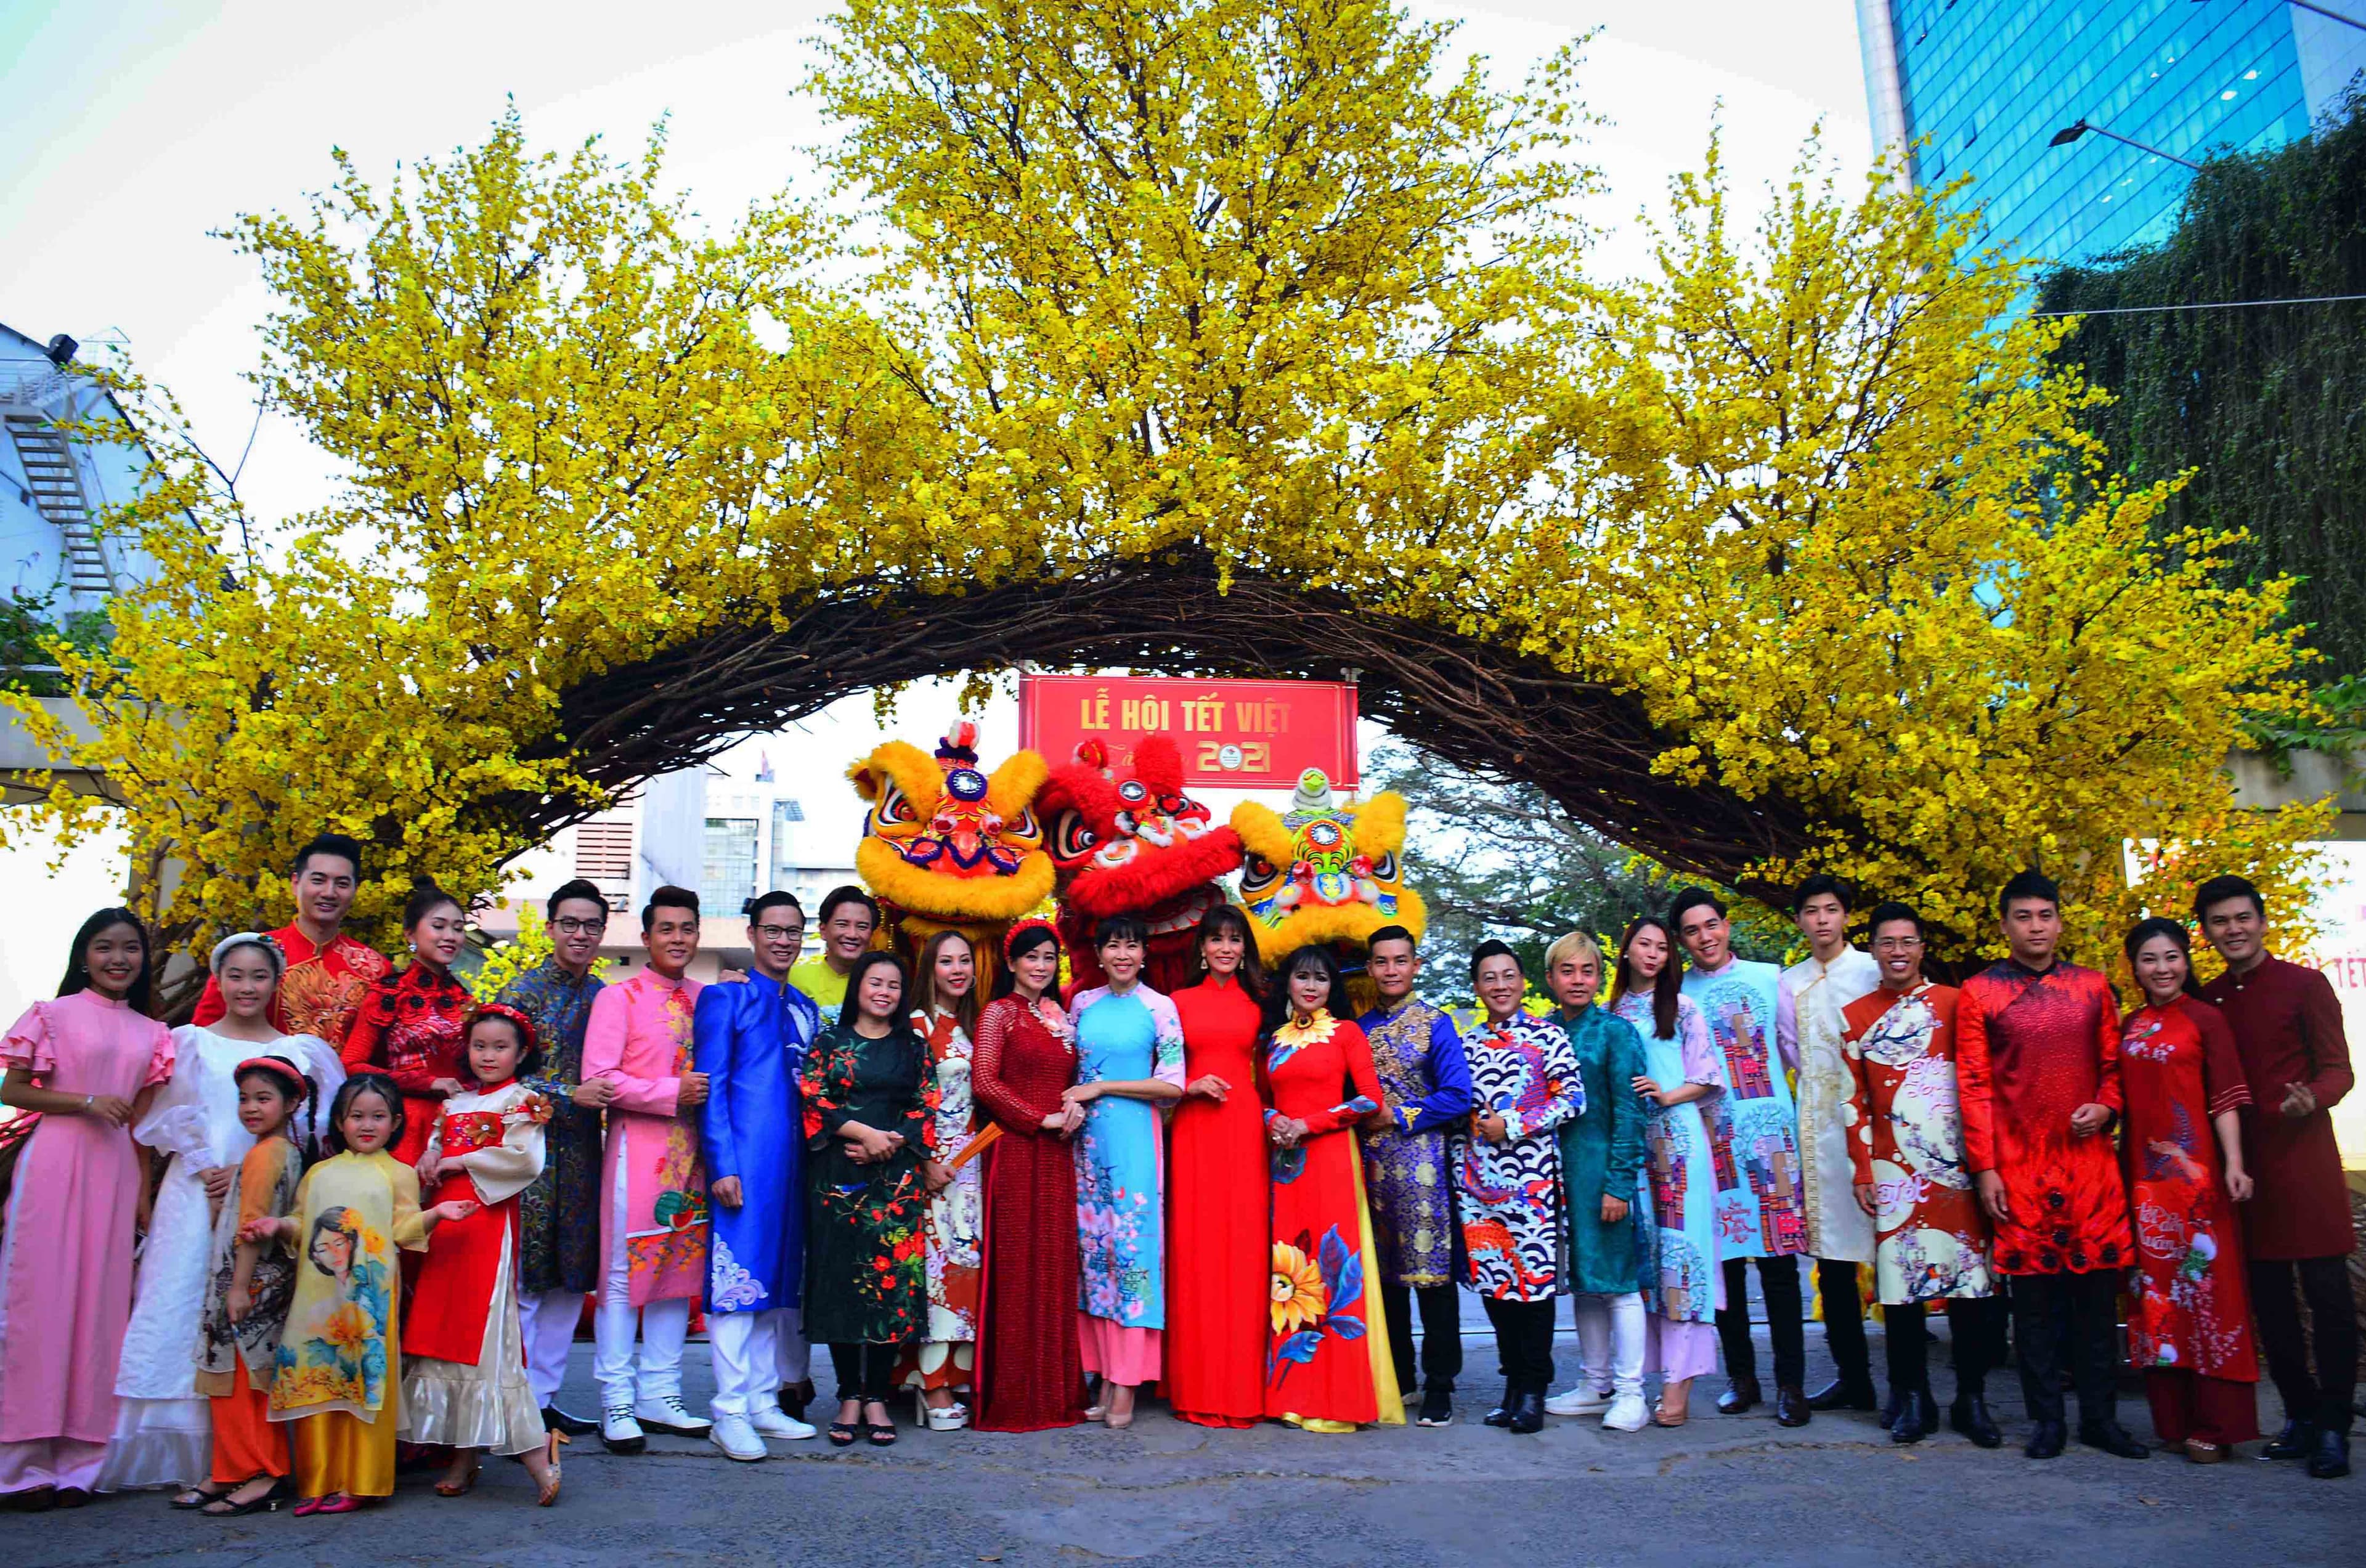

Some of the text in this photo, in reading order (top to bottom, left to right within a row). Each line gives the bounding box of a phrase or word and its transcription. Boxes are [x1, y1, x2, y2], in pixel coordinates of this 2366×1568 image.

[1081, 687, 1291, 737] LỄ HỘI TẾT VIỆT
